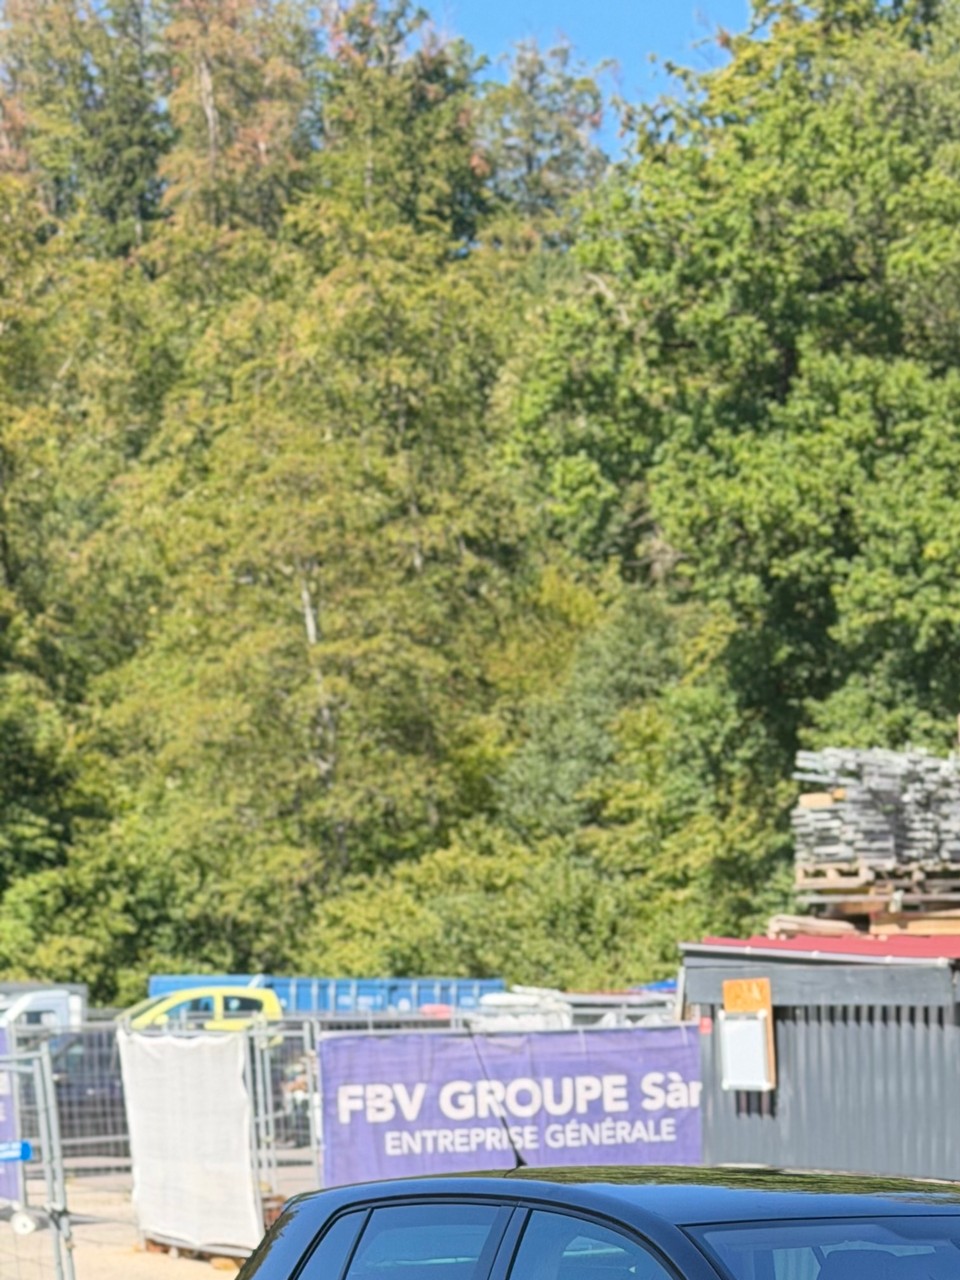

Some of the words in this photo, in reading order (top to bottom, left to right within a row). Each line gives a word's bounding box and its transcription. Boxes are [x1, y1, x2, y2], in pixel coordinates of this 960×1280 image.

[337, 1081, 427, 1125] FBV
[439, 1074, 628, 1120] GROUPE
[384, 1125, 539, 1156] ENTREPRISE
[545, 1117, 677, 1149] GÉNÉRALE
